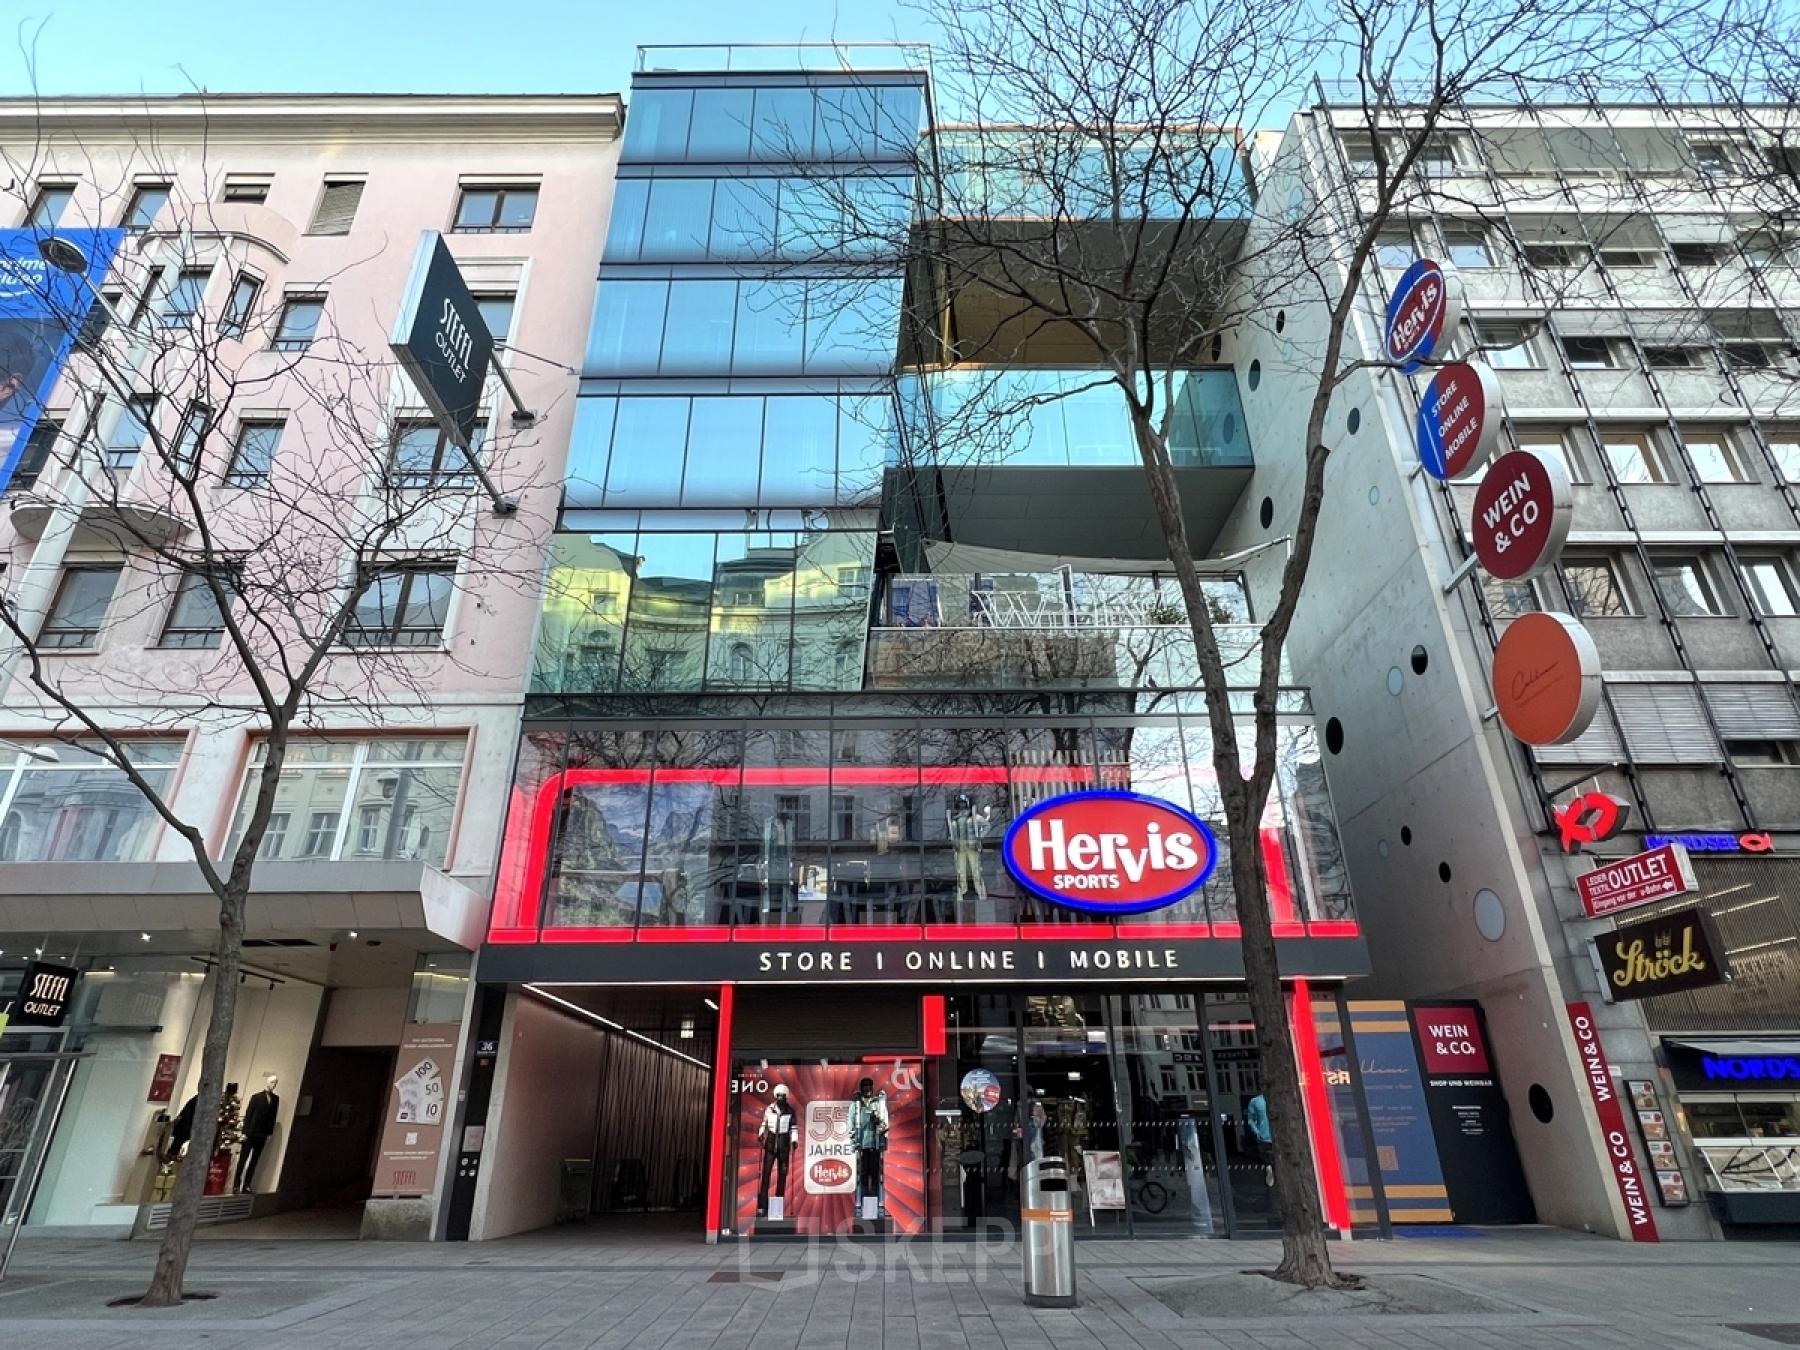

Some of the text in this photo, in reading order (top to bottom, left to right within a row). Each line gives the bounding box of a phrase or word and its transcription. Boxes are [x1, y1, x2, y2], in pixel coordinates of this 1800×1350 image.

[440, 298, 473, 370] STEFFL
[1392, 282, 1437, 351] Hervis
[436, 332, 467, 383] OUTLET
[1431, 380, 1458, 417] STORE
[1438, 396, 1469, 438] ONLINE
[1445, 416, 1478, 460] MOBILE
[1483, 472, 1531, 529] WEIN
[1494, 500, 1539, 553] & CO
[1028, 818, 1198, 883] Hervis
[1053, 874, 1120, 889] SPORTS
[1608, 854, 1667, 889] OUTLET
[759, 952, 852, 971] STORE
[906, 951, 1015, 970] ONLINE
[1071, 950, 1178, 969] MOBILE
[1613, 926, 1706, 987] Ströck
[30, 973, 69, 1001] STEFFL
[24, 1001, 61, 1017] OUTLET
[1428, 1025, 1469, 1037] WEIN
[415, 1061, 433, 1078] 100
[1575, 1016, 1612, 1102] WEIN & CO
[425, 1082, 439, 1095] 50
[426, 1103, 438, 1117] 10
[808, 1106, 852, 1142] 55
[808, 1144, 851, 1156] JAHRE
[813, 1165, 849, 1182] Hervis
[1609, 1131, 1648, 1225] WEIN & CO
